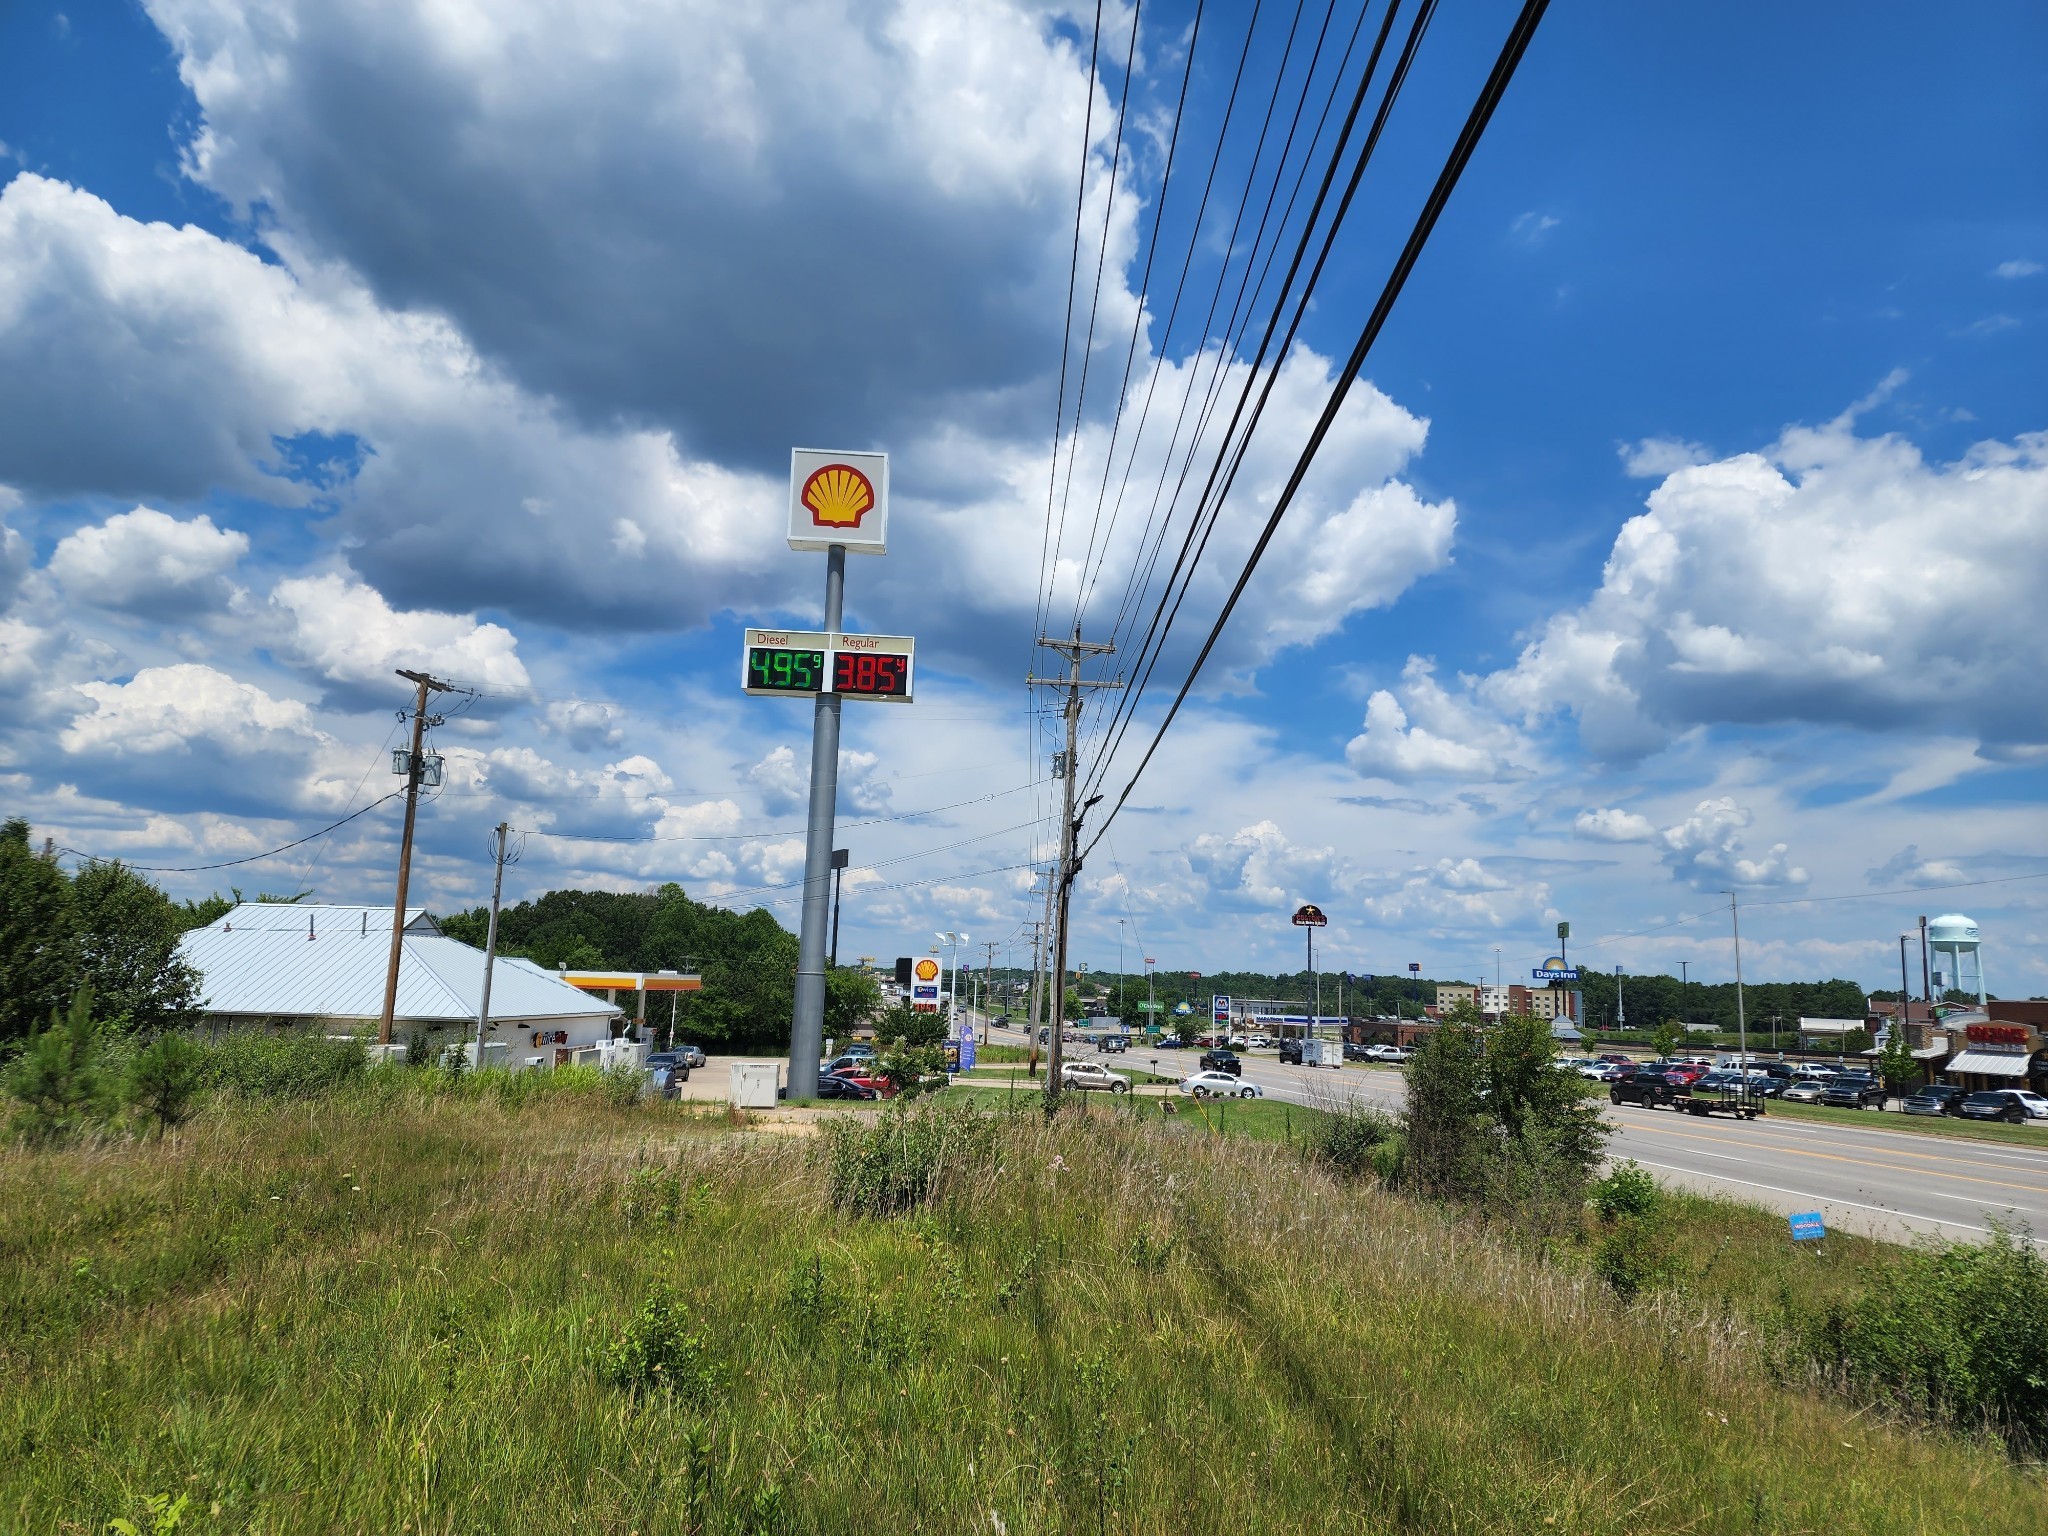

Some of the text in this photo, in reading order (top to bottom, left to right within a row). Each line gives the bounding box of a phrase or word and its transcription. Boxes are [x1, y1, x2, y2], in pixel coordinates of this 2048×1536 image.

[757, 633, 789, 645] Diesel
[842, 636, 880, 650] Regular
[1536, 970, 1577, 979] Days Inn
